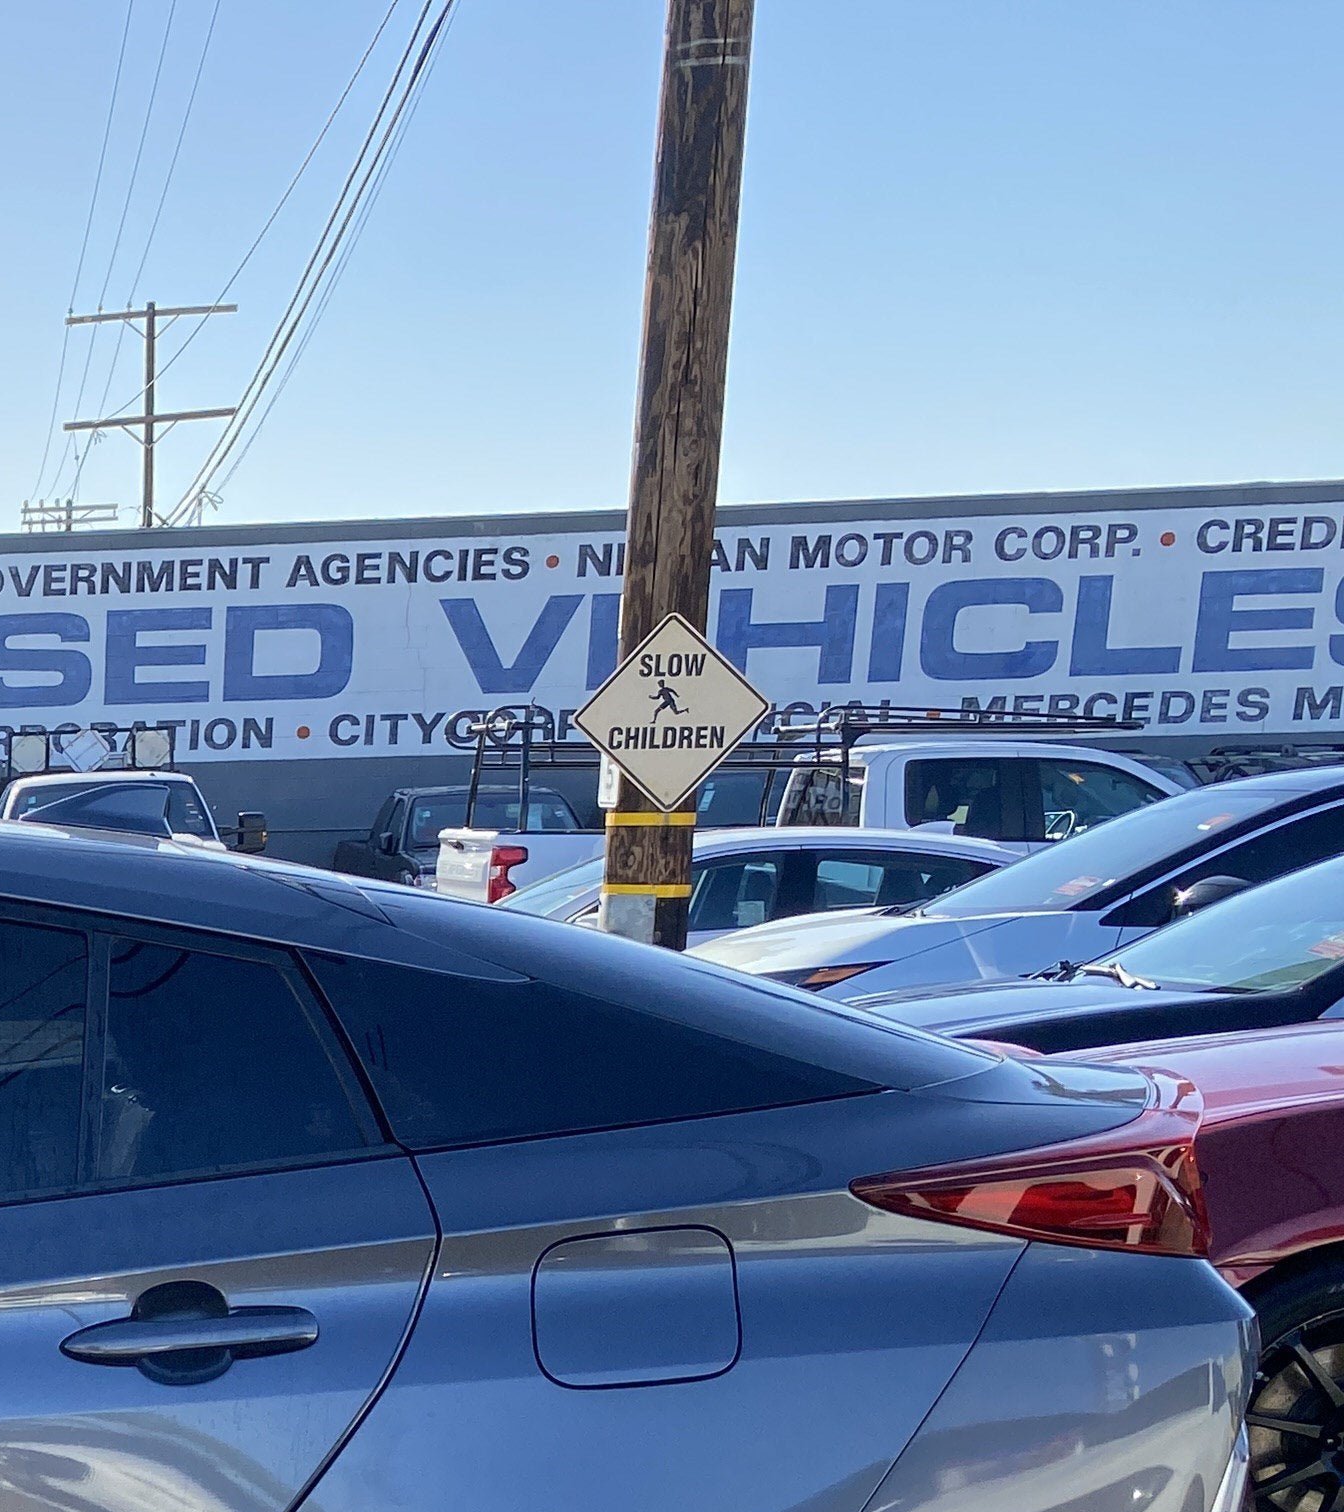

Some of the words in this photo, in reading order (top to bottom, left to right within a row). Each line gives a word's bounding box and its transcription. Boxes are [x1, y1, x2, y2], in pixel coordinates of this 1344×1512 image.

[285, 546, 531, 588] AGENCIES
[577, 537, 771, 578] NIAN
[788, 530, 974, 569] MOTOR
[994, 523, 1142, 562] CORP.
[639, 653, 706, 678] SLOW
[960, 687, 1271, 725] MERCEDES
[607, 725, 725, 750] CHILDREN
